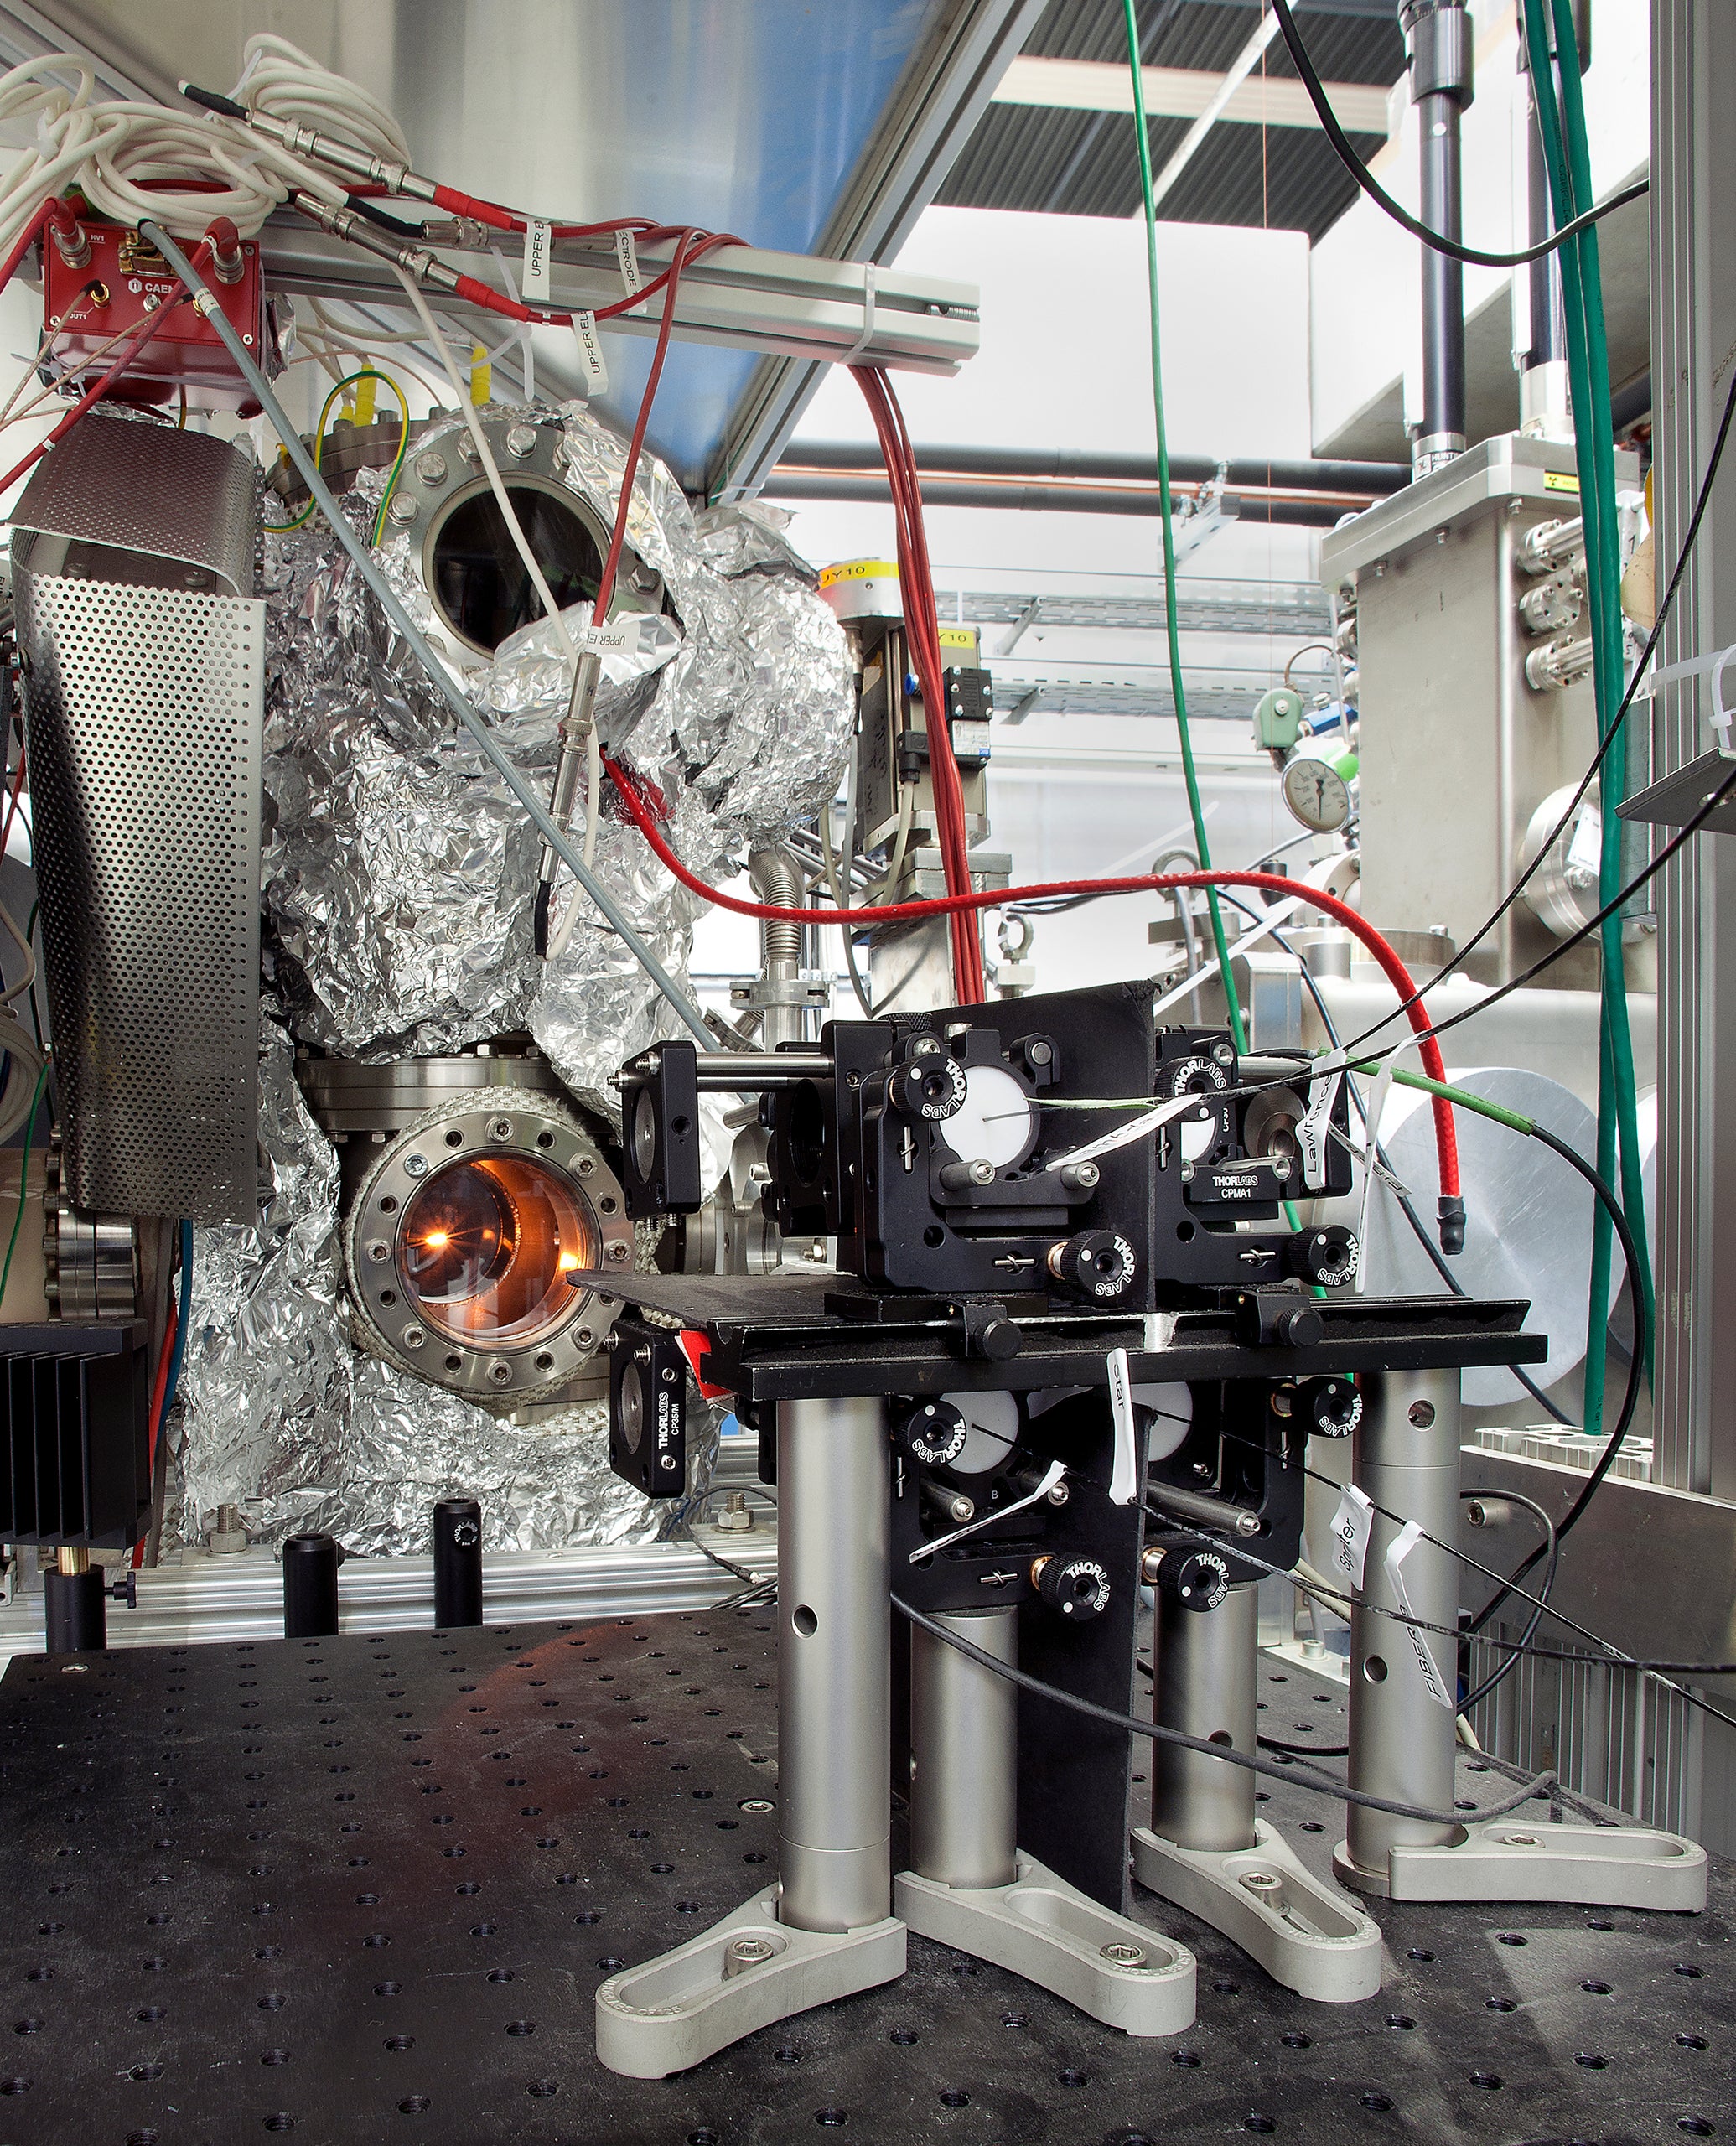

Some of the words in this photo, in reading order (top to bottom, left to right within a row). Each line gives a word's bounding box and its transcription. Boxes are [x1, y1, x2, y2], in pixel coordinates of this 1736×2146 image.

[90, 233, 106, 242] HV1
[531, 232, 544, 277] UPPER
[583, 332, 601, 375] UPPER
[599, 635, 626, 646] UPPER
[920, 1058, 967, 1119] THORLABS
[1174, 1055, 1226, 1096] THORLABS
[1303, 1075, 1333, 1173] Lawrence
[1211, 1175, 1258, 1186] THORLABS
[1220, 1188, 1251, 1199] CPMA1
[1095, 1235, 1137, 1297] THORLABS
[1317, 1234, 1360, 1285] THORLABS
[658, 1392, 669, 1449] THORLABS
[671, 1403, 680, 1436] CP35/M
[1319, 1393, 1363, 1438] THORLABS
[912, 1418, 966, 1464] THORLABS
[991, 1490, 998, 1499] B
[1066, 1561, 1111, 1612] THORLABS
[1195, 1552, 1230, 1609] THORLABS
[1407, 1625, 1441, 1698] FIBER
